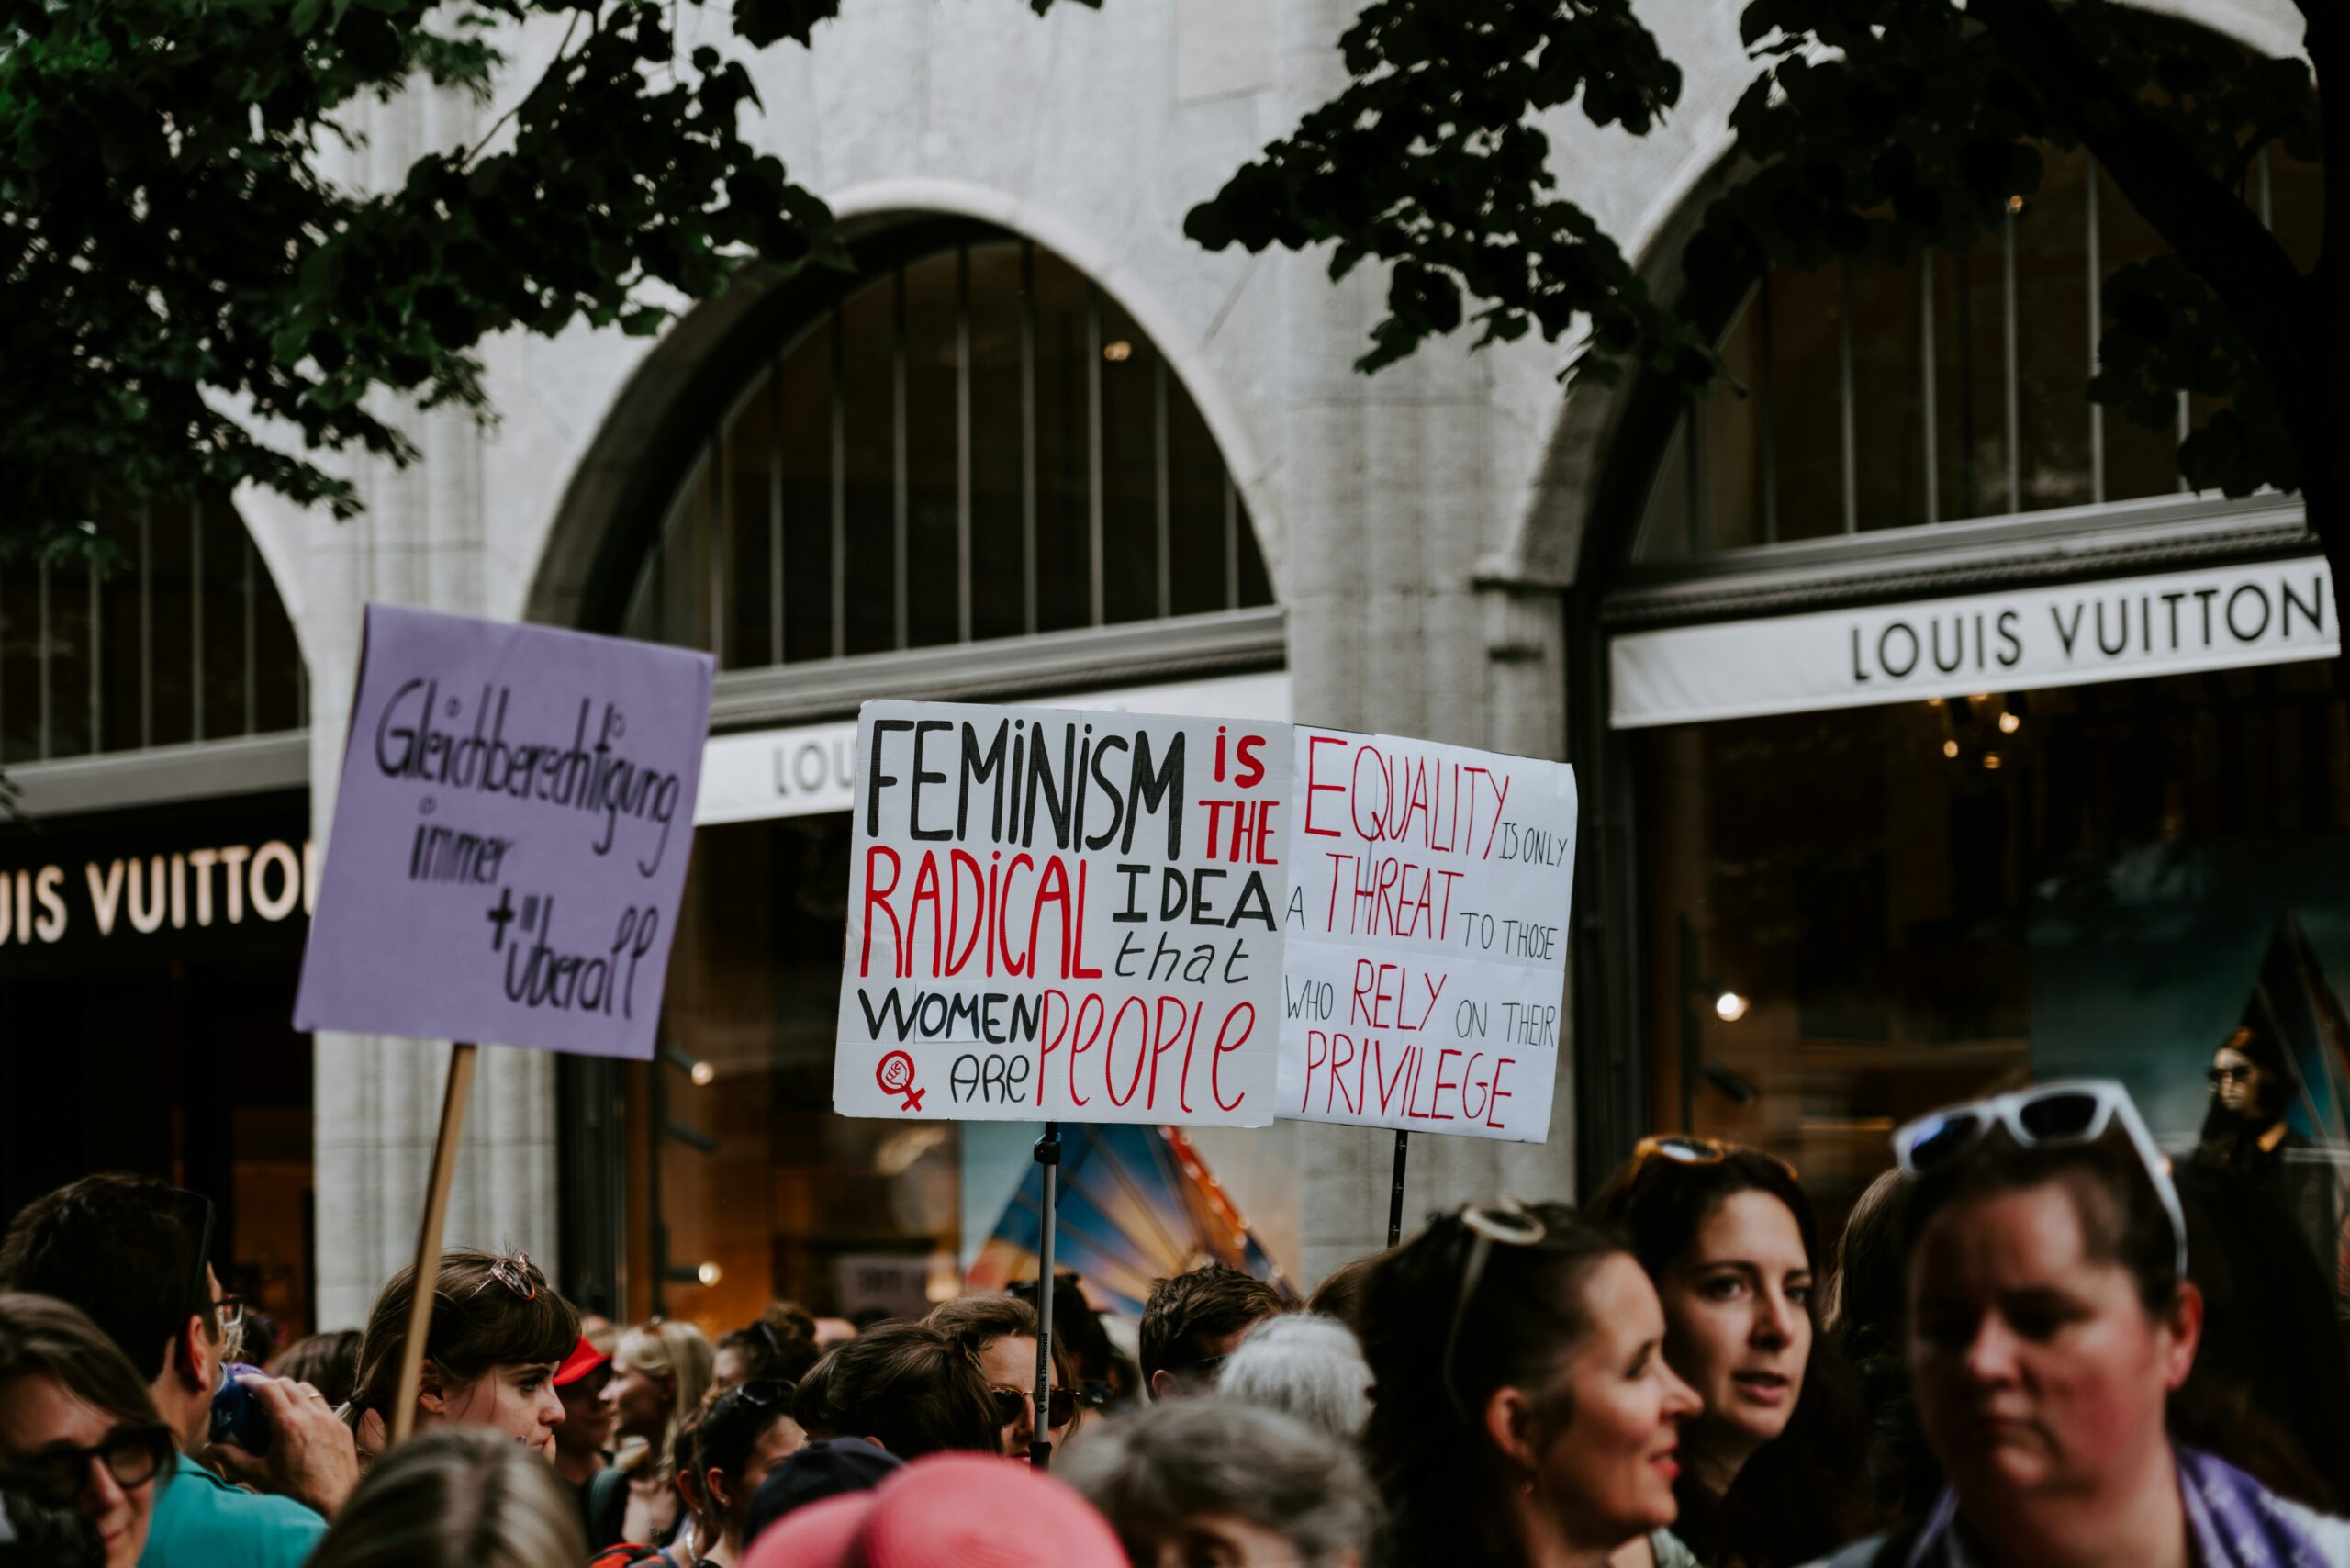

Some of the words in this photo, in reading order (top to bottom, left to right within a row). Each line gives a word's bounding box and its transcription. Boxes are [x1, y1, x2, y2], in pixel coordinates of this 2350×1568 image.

[1852, 610, 2023, 682] LOUIS
[2051, 576, 2323, 658] VUITTON
[375, 678, 680, 878] Gleichberechtigung
[1304, 735, 1510, 860] EQUALITY
[1498, 823, 1518, 859] IS
[1523, 827, 1568, 867] ONLY
[408, 797, 517, 886] immer
[1198, 800, 1280, 865] THE
[1112, 863, 1277, 931] IDEA
[1286, 886, 1304, 931] A
[1326, 852, 1464, 940] THREAT
[1460, 913, 1494, 950] TO
[1502, 920, 1558, 960] THOSE
[1114, 930, 1249, 985] that
[857, 987, 1043, 1044] WOMEN
[1286, 974, 1334, 1022] WHO
[1350, 958, 1448, 1032] RELY
[1455, 999, 1487, 1039] ON
[1501, 1002, 1556, 1047] THEIR
[1302, 1030, 1516, 1128] PRIVILEGE
[1038, 1376, 1047, 1403] Black
[1039, 1333, 1048, 1374] Diamond
